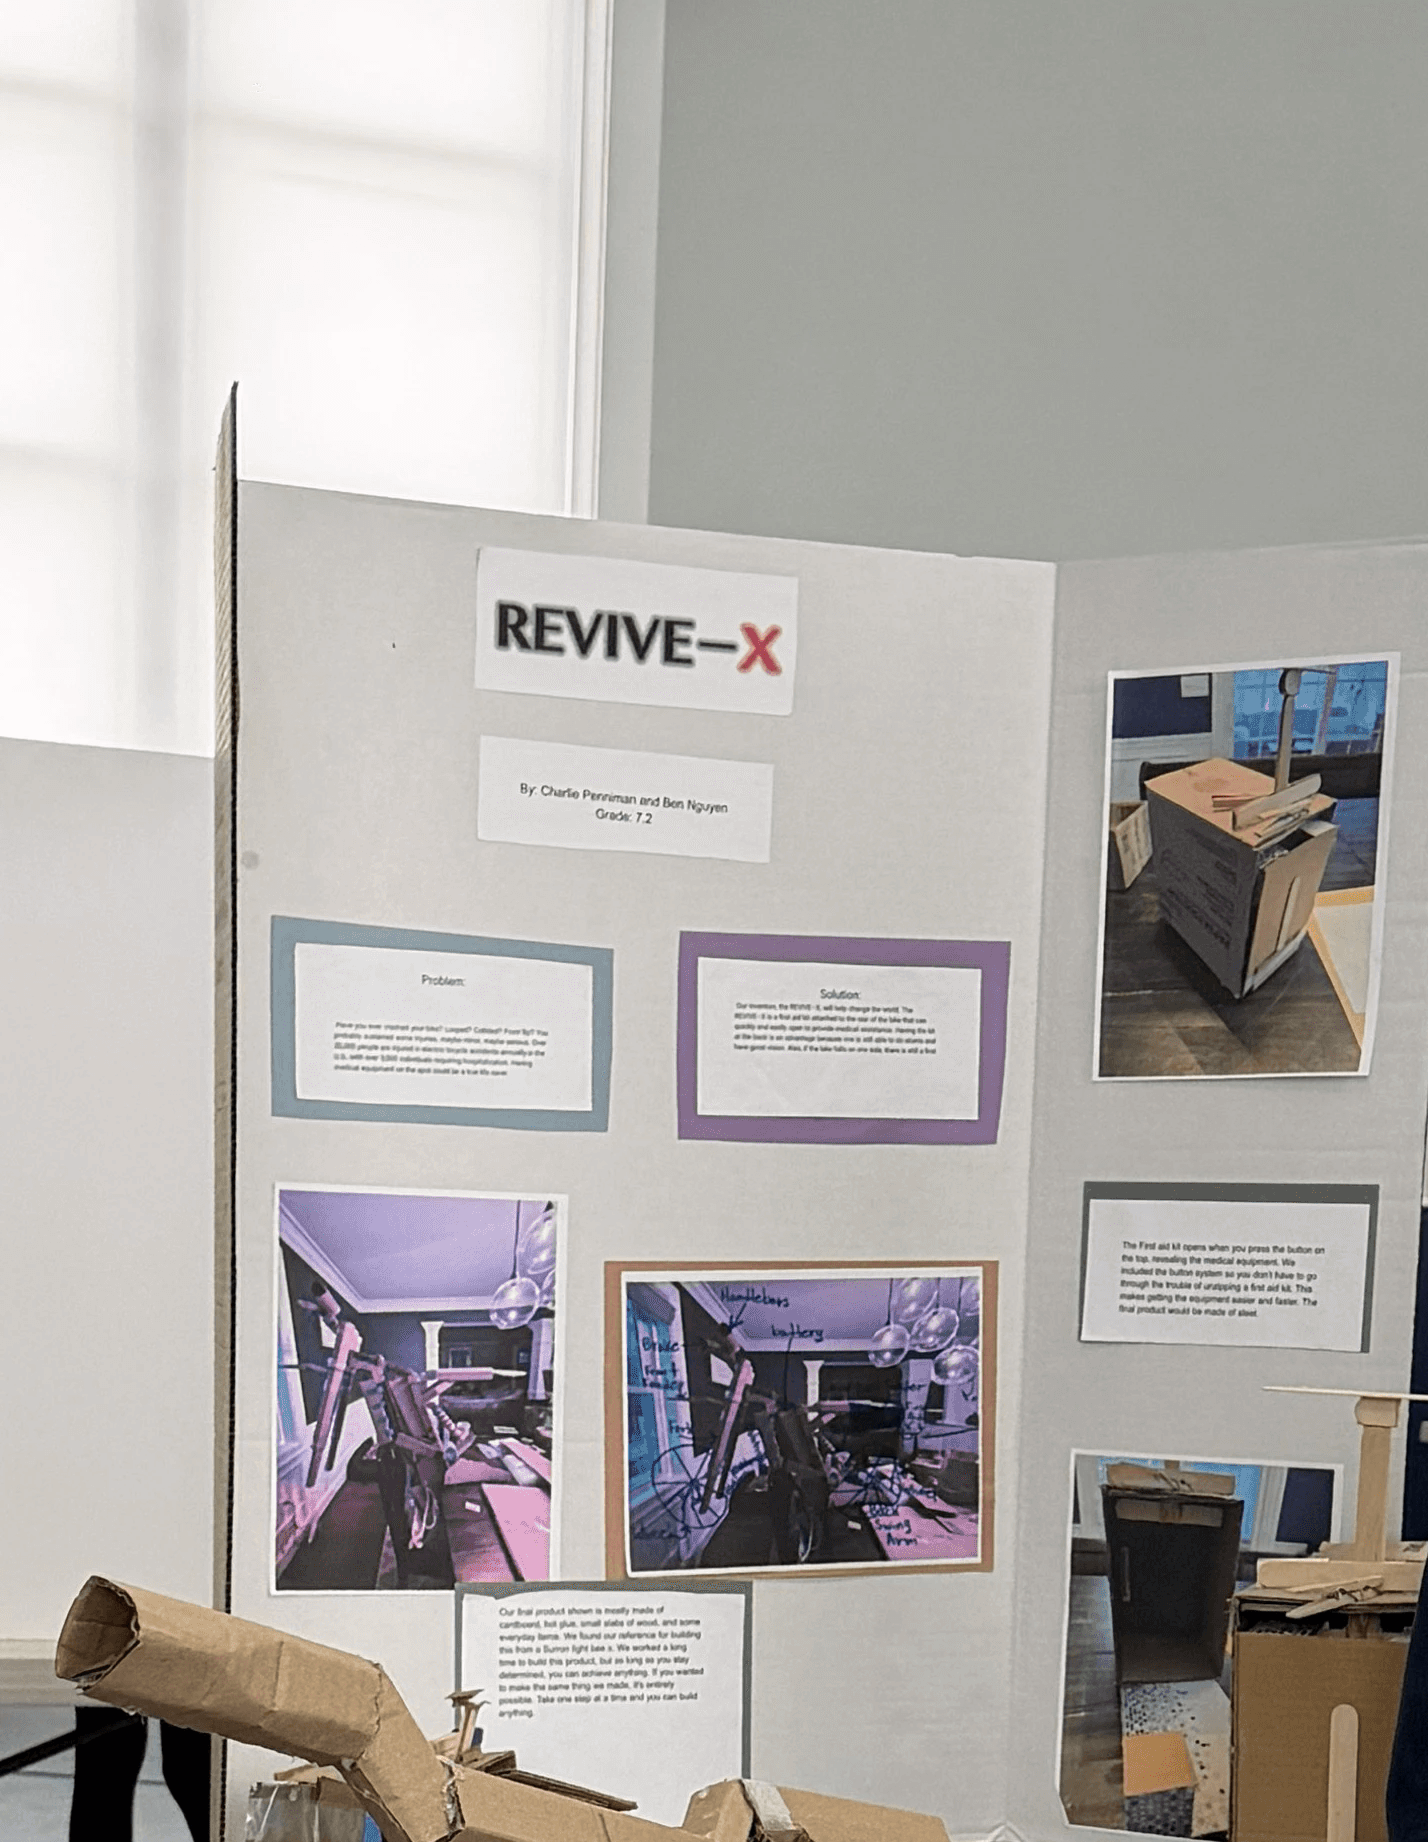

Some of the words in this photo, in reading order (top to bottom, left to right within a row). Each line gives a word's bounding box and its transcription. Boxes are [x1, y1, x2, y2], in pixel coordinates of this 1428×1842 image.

[541, 784, 579, 799] Charlie
[639, 796, 660, 807] and
[662, 798, 684, 810] Ben
[686, 799, 728, 815] Nguyen
[636, 811, 653, 825] 7.2
[772, 1322, 824, 1342] battery
